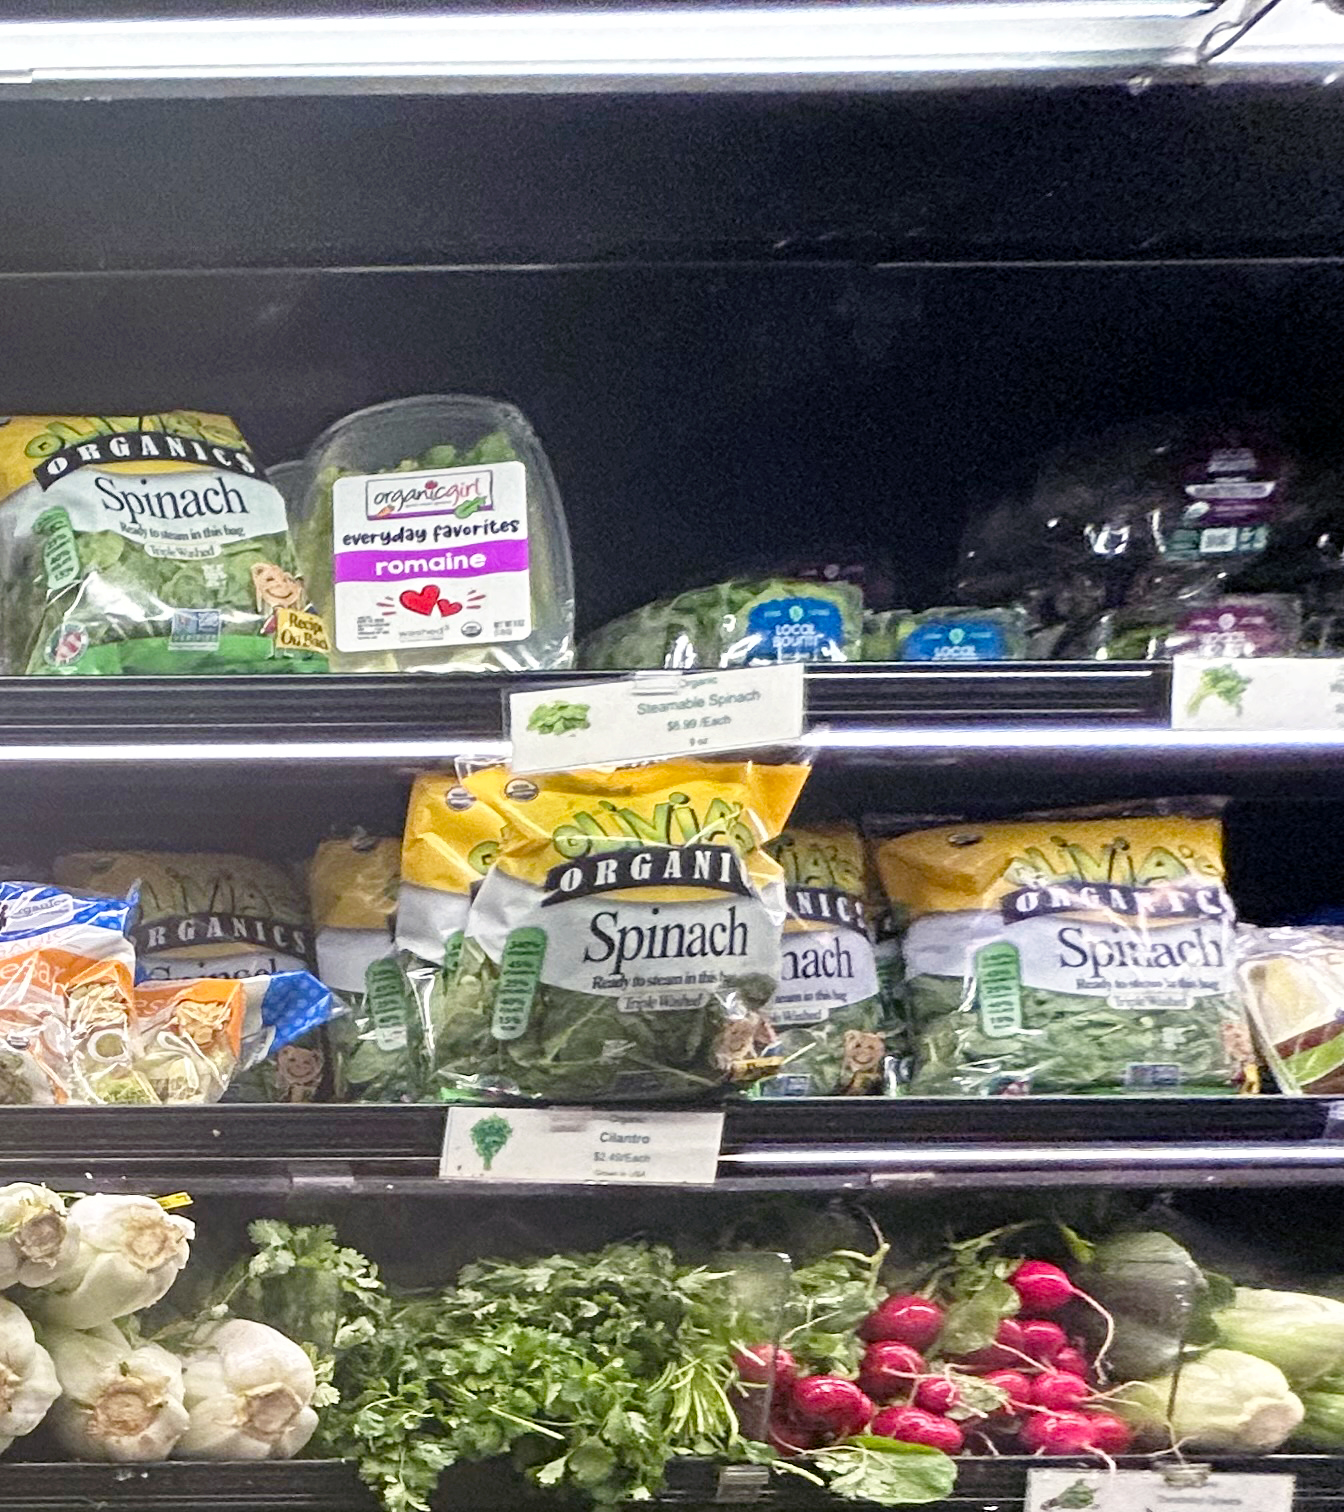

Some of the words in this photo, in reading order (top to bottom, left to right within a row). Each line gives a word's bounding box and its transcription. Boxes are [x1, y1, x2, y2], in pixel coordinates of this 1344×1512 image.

[46, 434, 256, 476] ORGANICS
[94, 475, 250, 526] Spinach
[373, 477, 481, 512] organicgirl
[342, 526, 428, 546] everyday
[432, 518, 521, 542] favorites
[375, 551, 487, 576] romaine
[636, 697, 706, 715] Steamable
[708, 690, 762, 709] Spinach
[560, 849, 750, 893] ORGANI
[795, 890, 867, 929] NICS
[133, 916, 307, 954] RGANICS
[582, 905, 749, 976] Spinach
[1057, 926, 1224, 979] Spinach
[781, 936, 855, 980] nach
[599, 1131, 651, 1144] Cilantro
